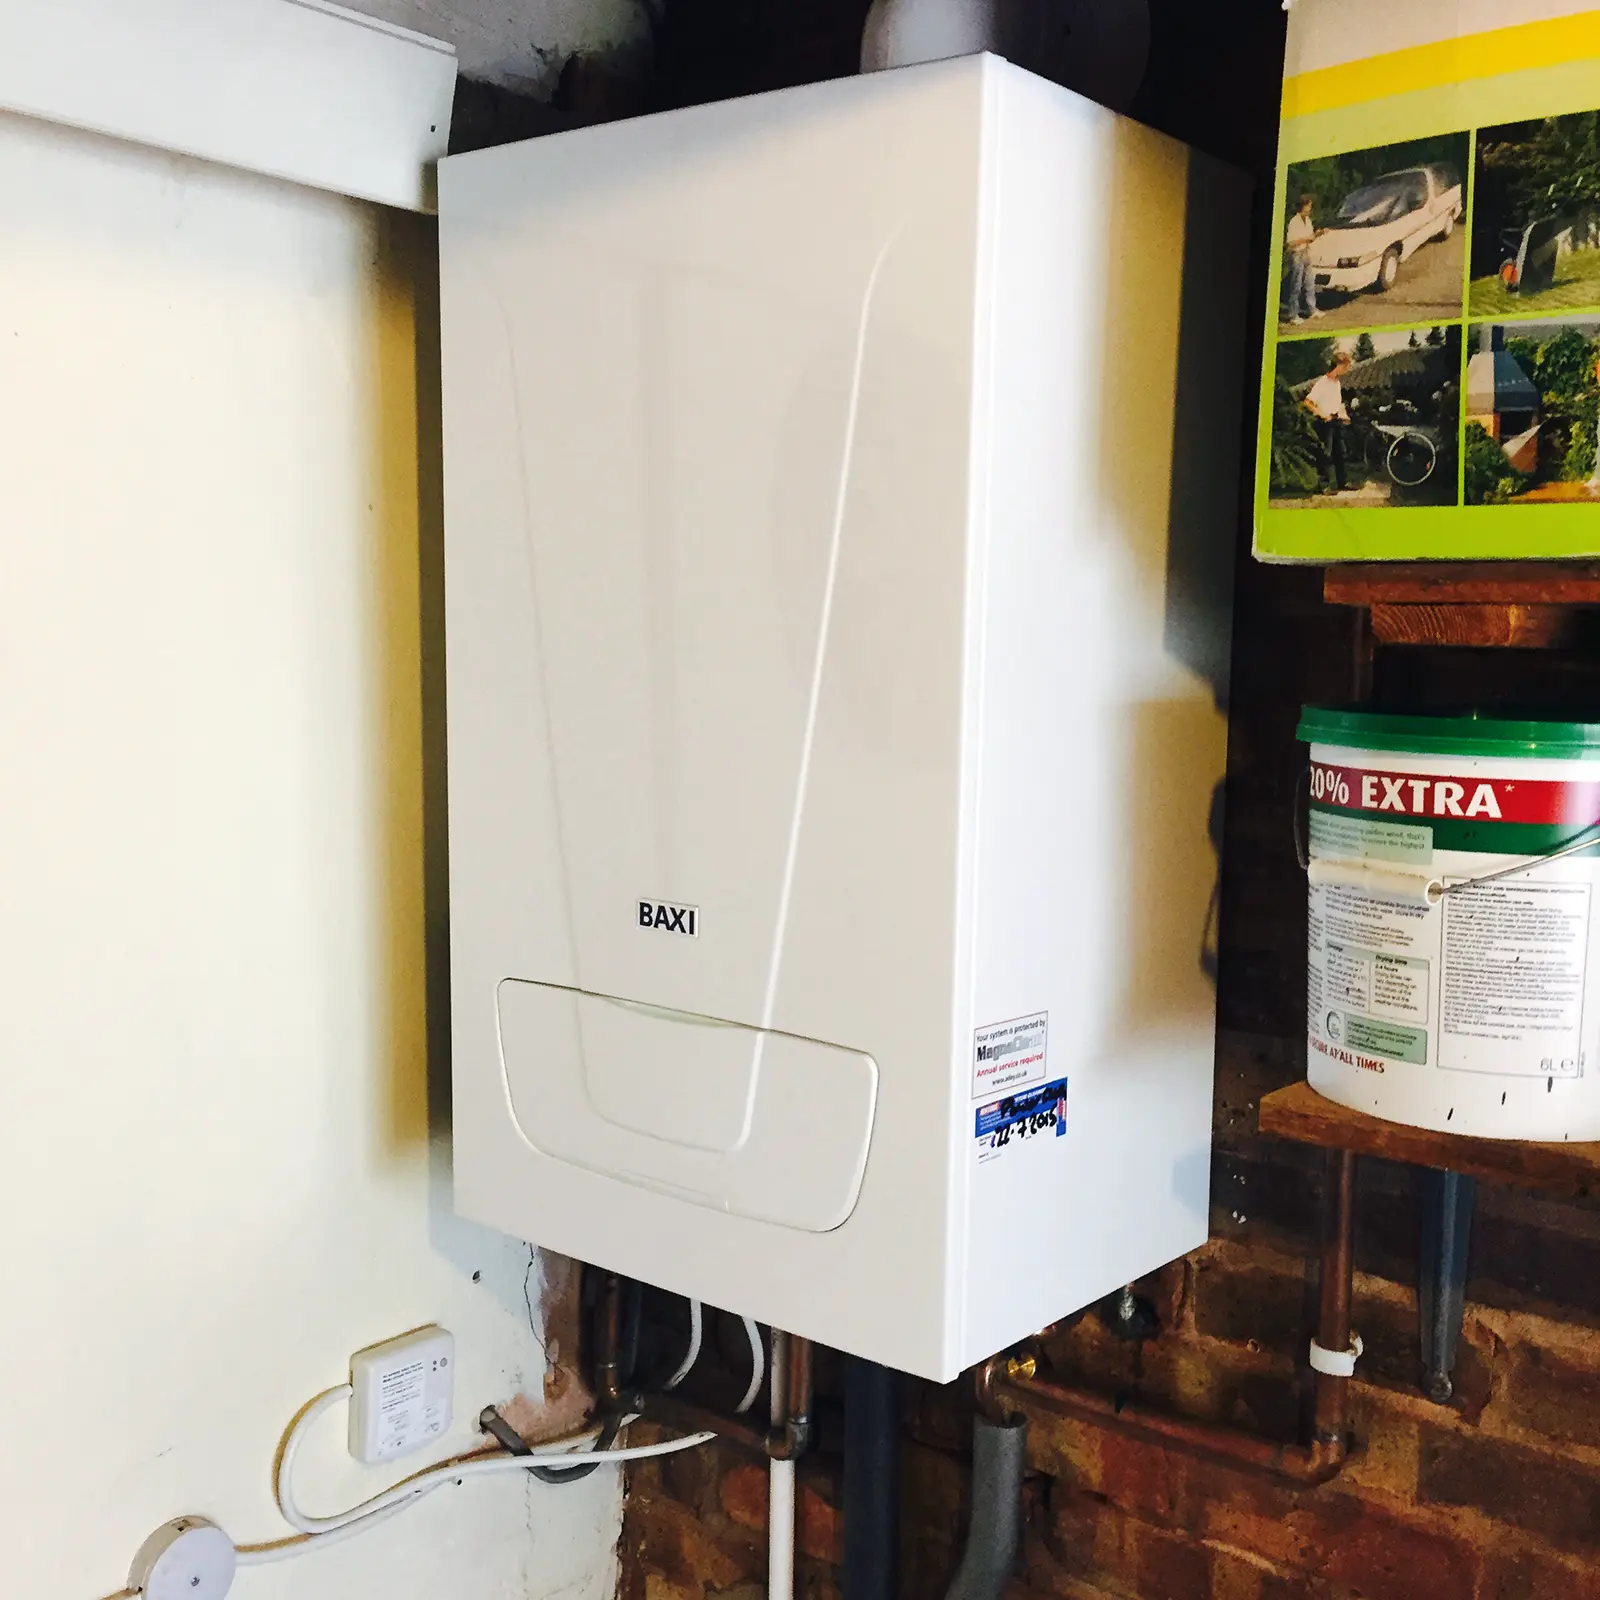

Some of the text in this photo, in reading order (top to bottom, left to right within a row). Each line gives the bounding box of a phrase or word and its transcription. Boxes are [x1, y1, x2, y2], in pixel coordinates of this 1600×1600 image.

[639, 902, 695, 935] BAXI
[1014, 1020, 1039, 1035] protected
[976, 1052, 1044, 1078] Annual service required
[1340, 1051, 1354, 1066] ALL
[1356, 1055, 1385, 1074] TIMES
